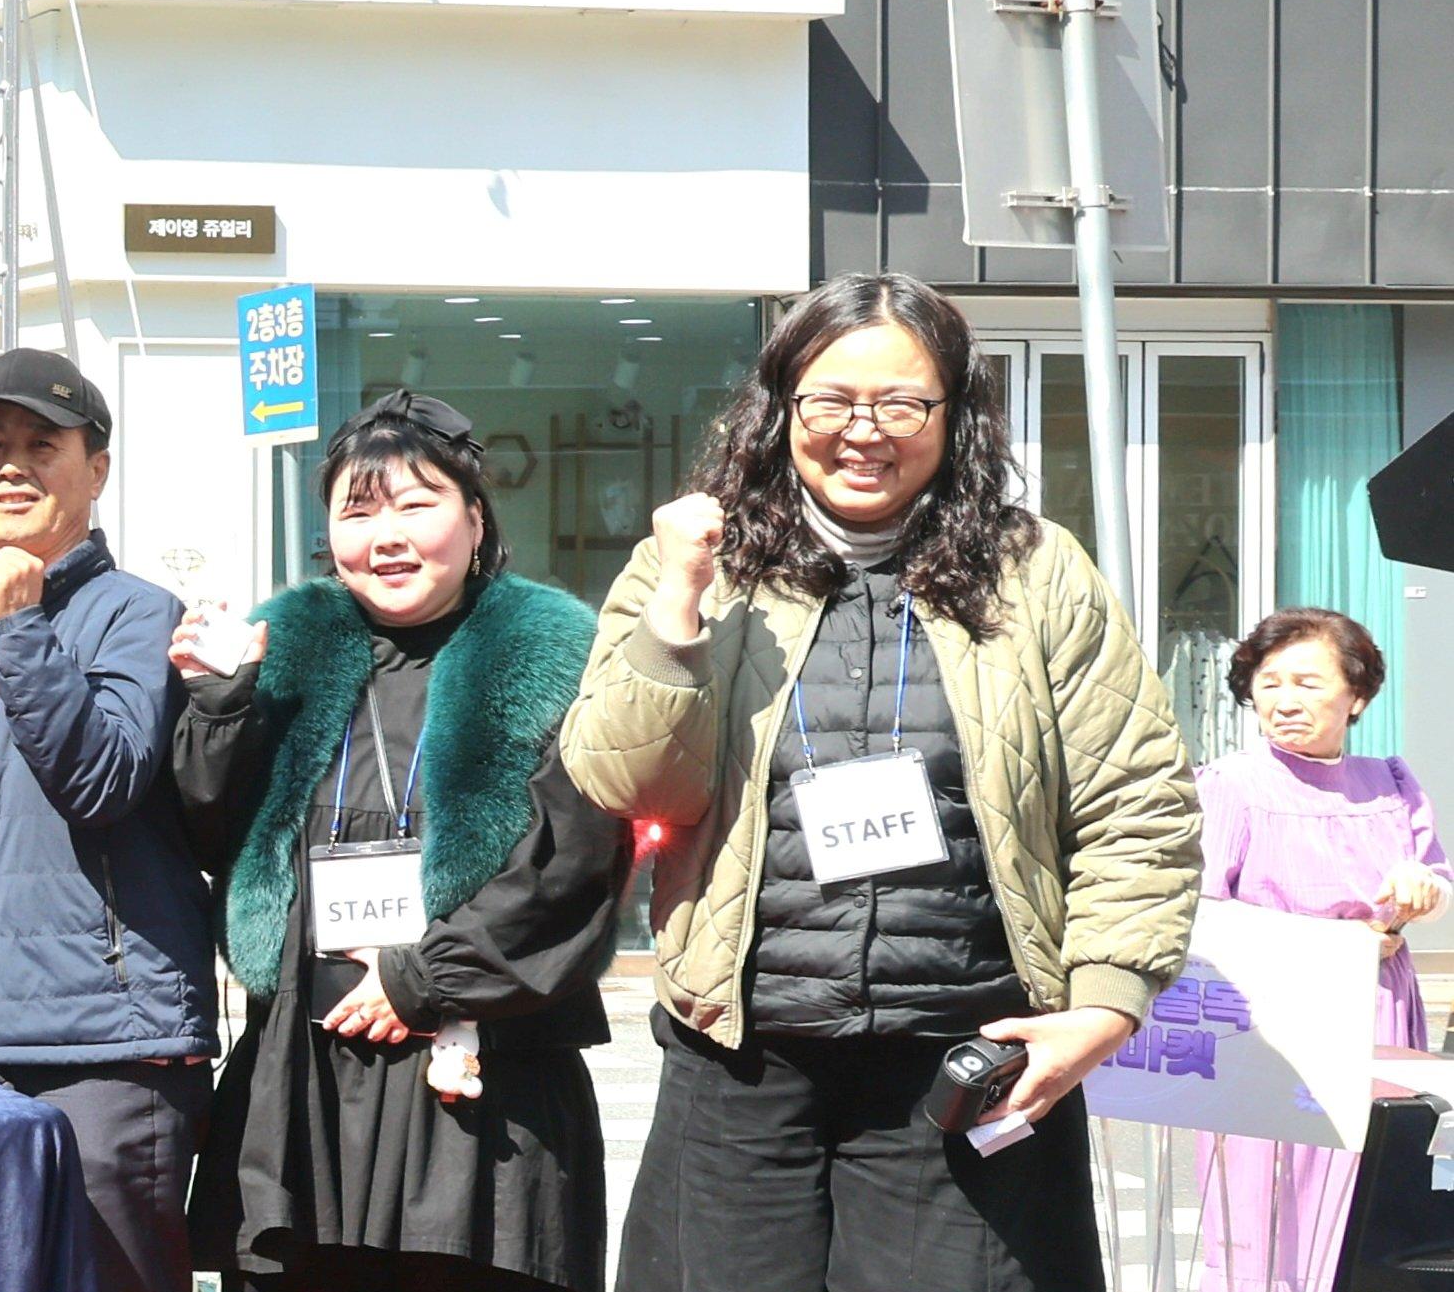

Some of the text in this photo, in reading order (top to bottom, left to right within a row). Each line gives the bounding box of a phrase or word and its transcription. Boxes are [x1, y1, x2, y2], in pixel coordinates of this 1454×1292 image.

[202, 219, 252, 238] 쥬얼리
[246, 297, 304, 344] 2층3층
[249, 344, 304, 391] 주차장
[821, 810, 916, 848] STAFF
[328, 896, 409, 923] STAFF
